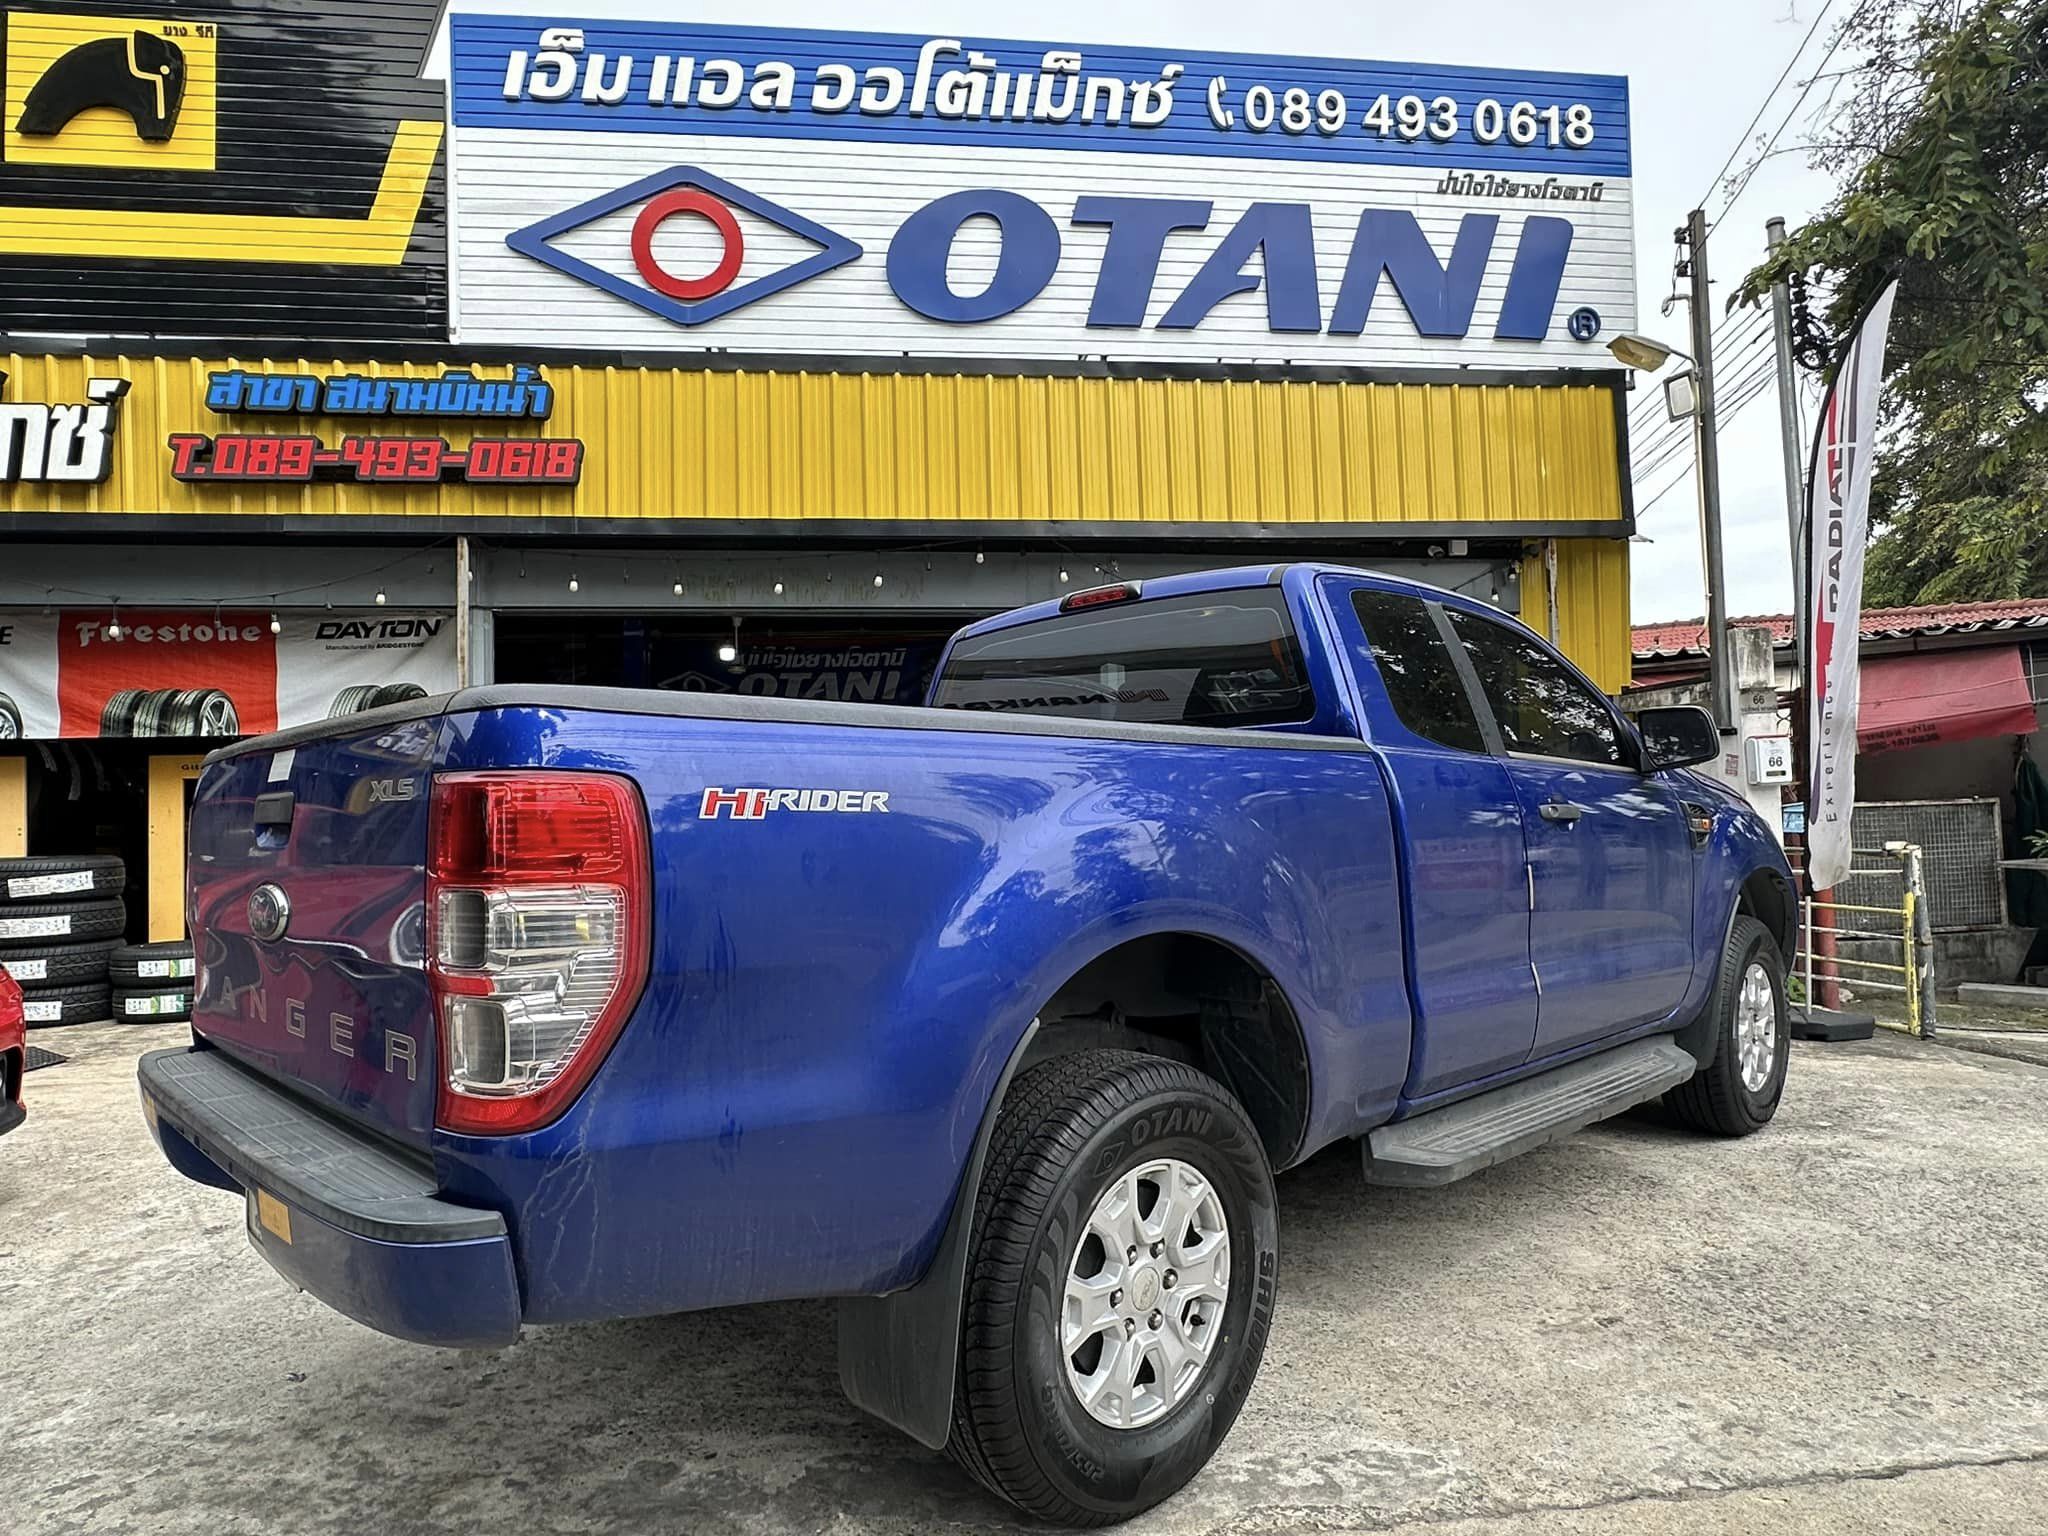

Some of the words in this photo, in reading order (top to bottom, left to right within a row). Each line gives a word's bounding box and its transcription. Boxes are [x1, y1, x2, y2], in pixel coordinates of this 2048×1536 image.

[503, 27, 634, 105] เอ็ม
[648, 55, 796, 110] แอล
[811, 38, 1184, 127] ออโต้แม็กซ์
[1244, 85, 1346, 134] 089
[1362, 94, 1458, 141] 493
[1473, 99, 1594, 148] 0618
[886, 189, 1574, 341] OTANI
[208, 373, 317, 409] สาขา
[326, 365, 550, 414] สนามบินน้ำ
[171, 437, 578, 479] T.089-493-0618
[76, 620, 261, 648] Firestone
[315, 619, 442, 640] DAYTON
[738, 671, 902, 701] OTANI
[1768, 756, 1783, 768] 66
[368, 777, 415, 802] XLS
[1131, 1106, 1214, 1147] OTANI
